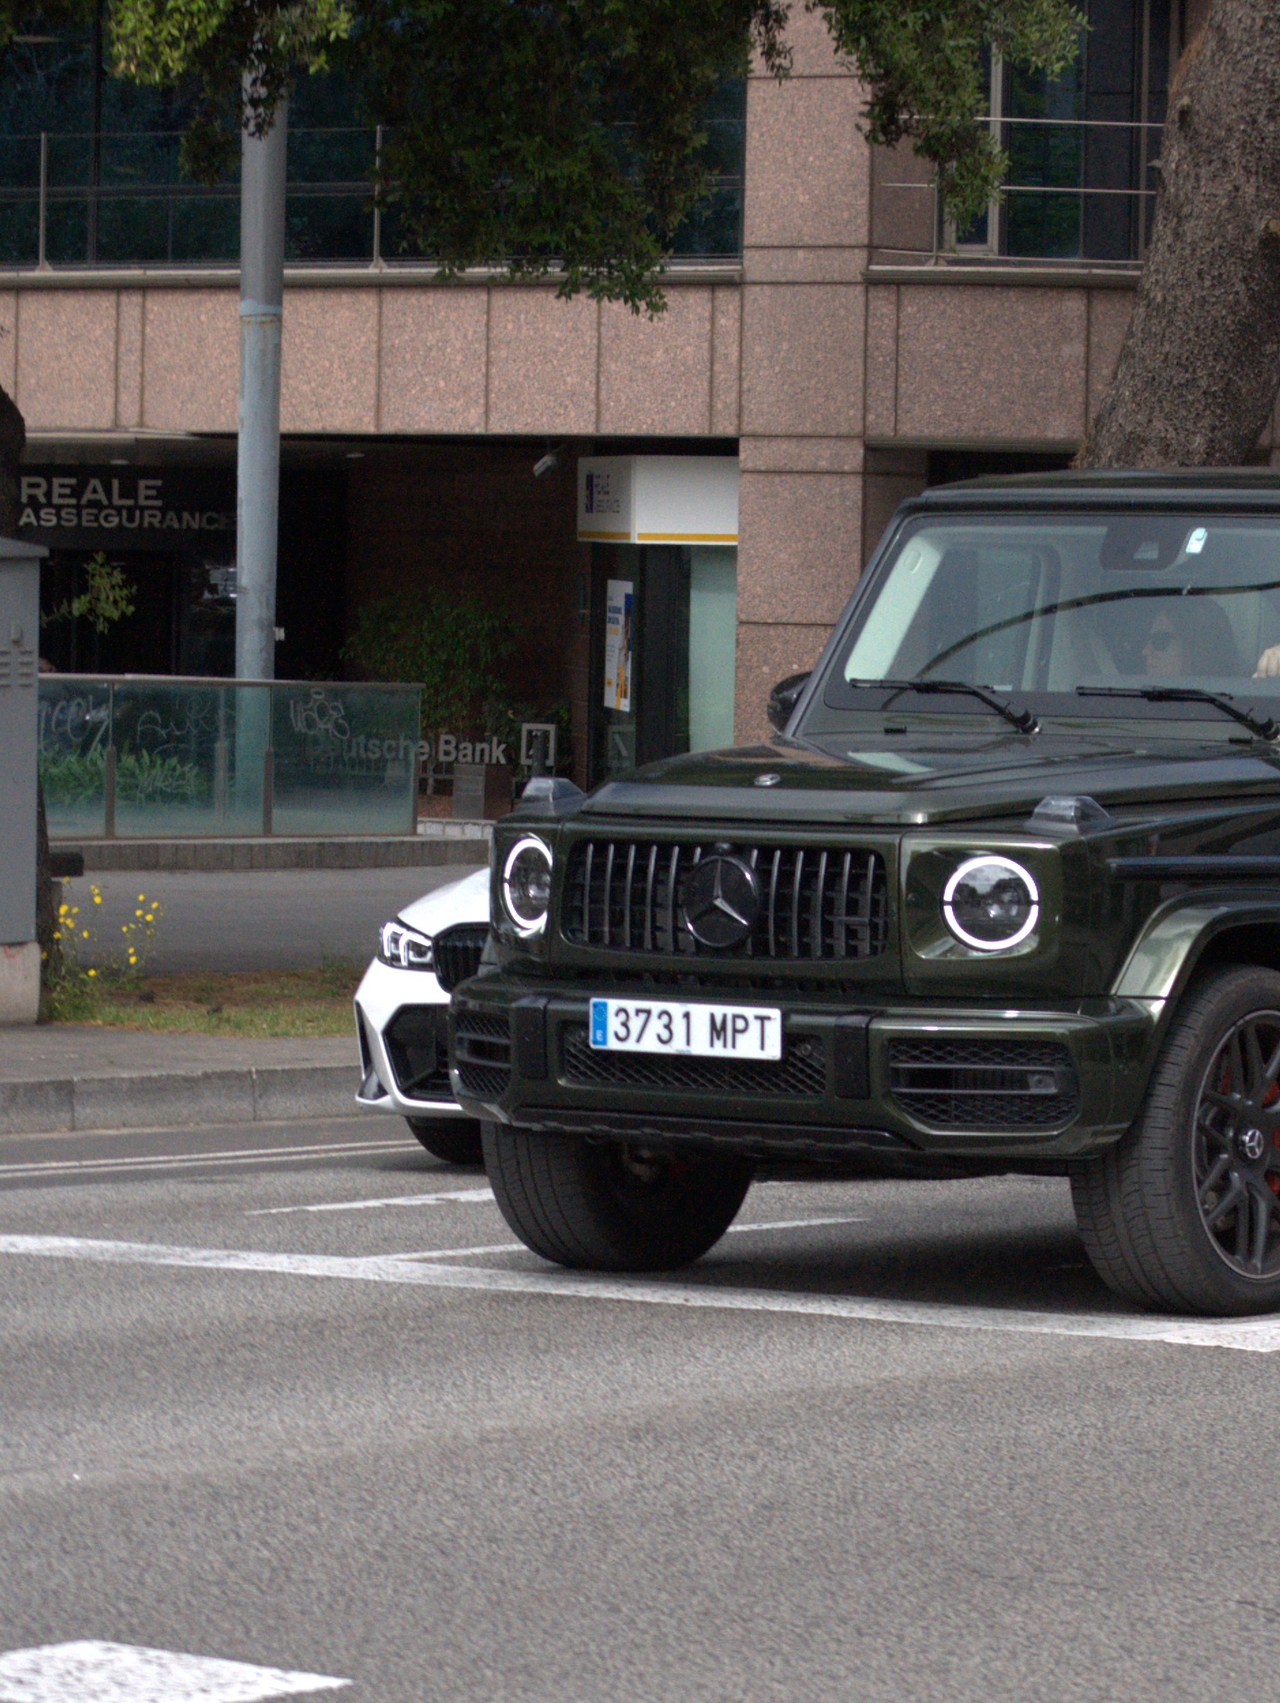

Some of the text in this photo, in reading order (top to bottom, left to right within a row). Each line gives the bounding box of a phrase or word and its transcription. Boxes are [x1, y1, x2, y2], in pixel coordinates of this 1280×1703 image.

[20, 476, 163, 507] REALE
[18, 507, 238, 531] ASSEGURANCE
[439, 734, 507, 765] Bank
[614, 1007, 772, 1051] 3731 MPT
